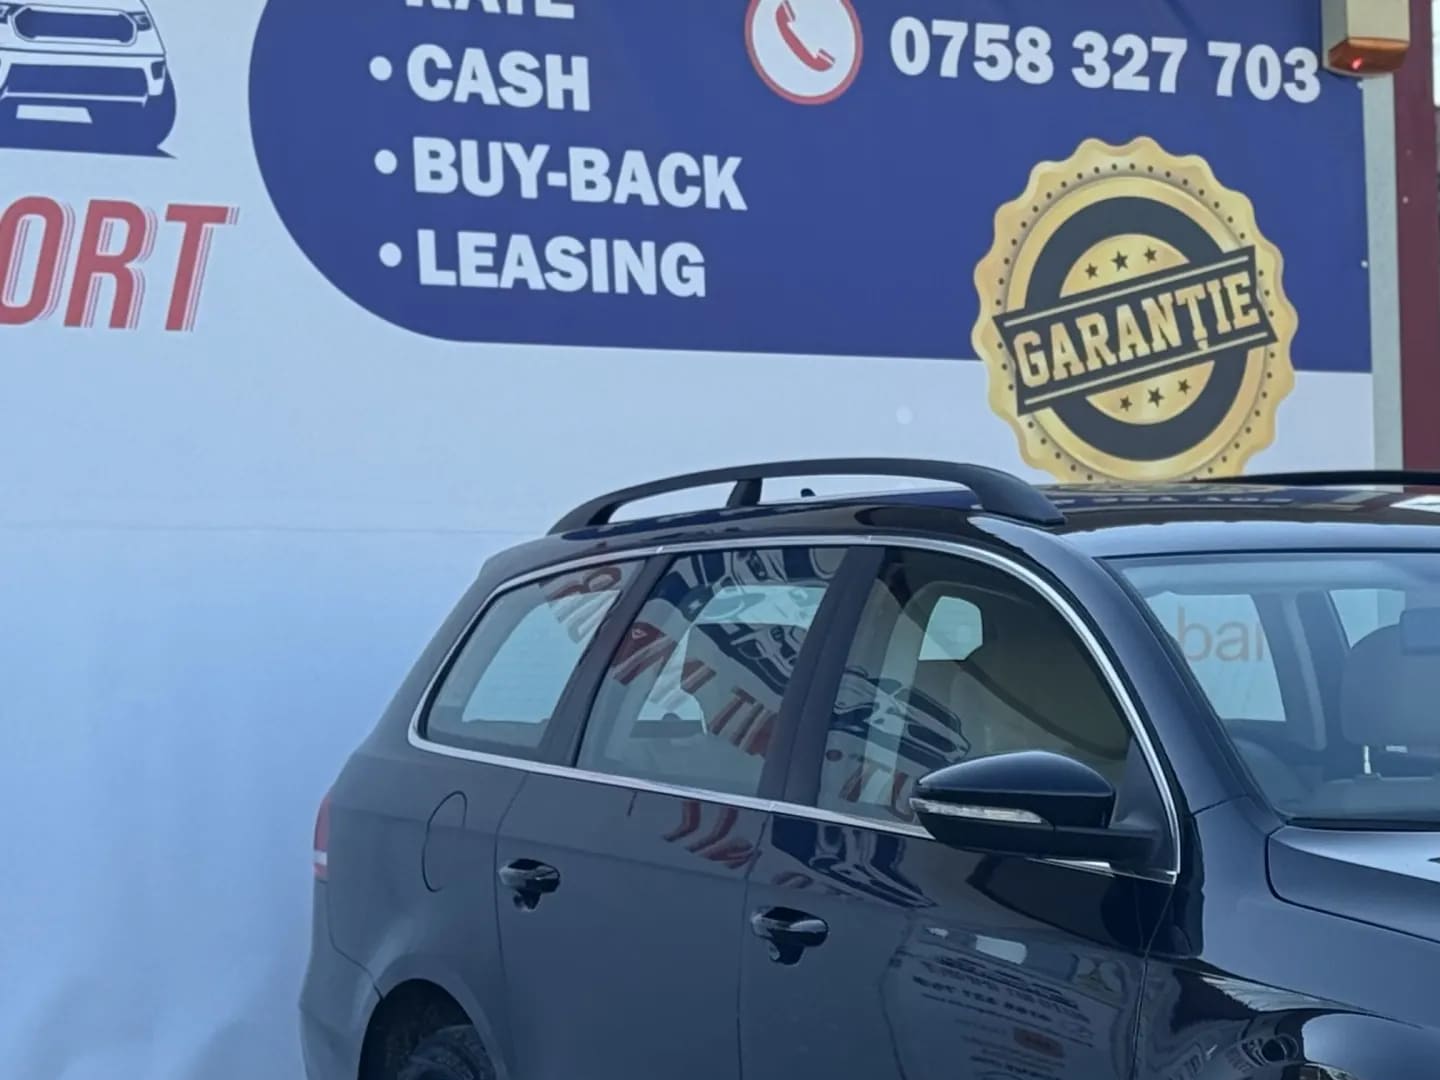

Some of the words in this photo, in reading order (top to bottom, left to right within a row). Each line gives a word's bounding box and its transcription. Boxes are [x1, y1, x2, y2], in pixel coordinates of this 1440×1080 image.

[406, 44, 591, 112] CASH
[890, 16, 1054, 84] 0758
[1071, 31, 1188, 93] 327
[1208, 42, 1321, 103] 703
[413, 137, 747, 210] BUY-BACK
[417, 229, 706, 297] LEASING
